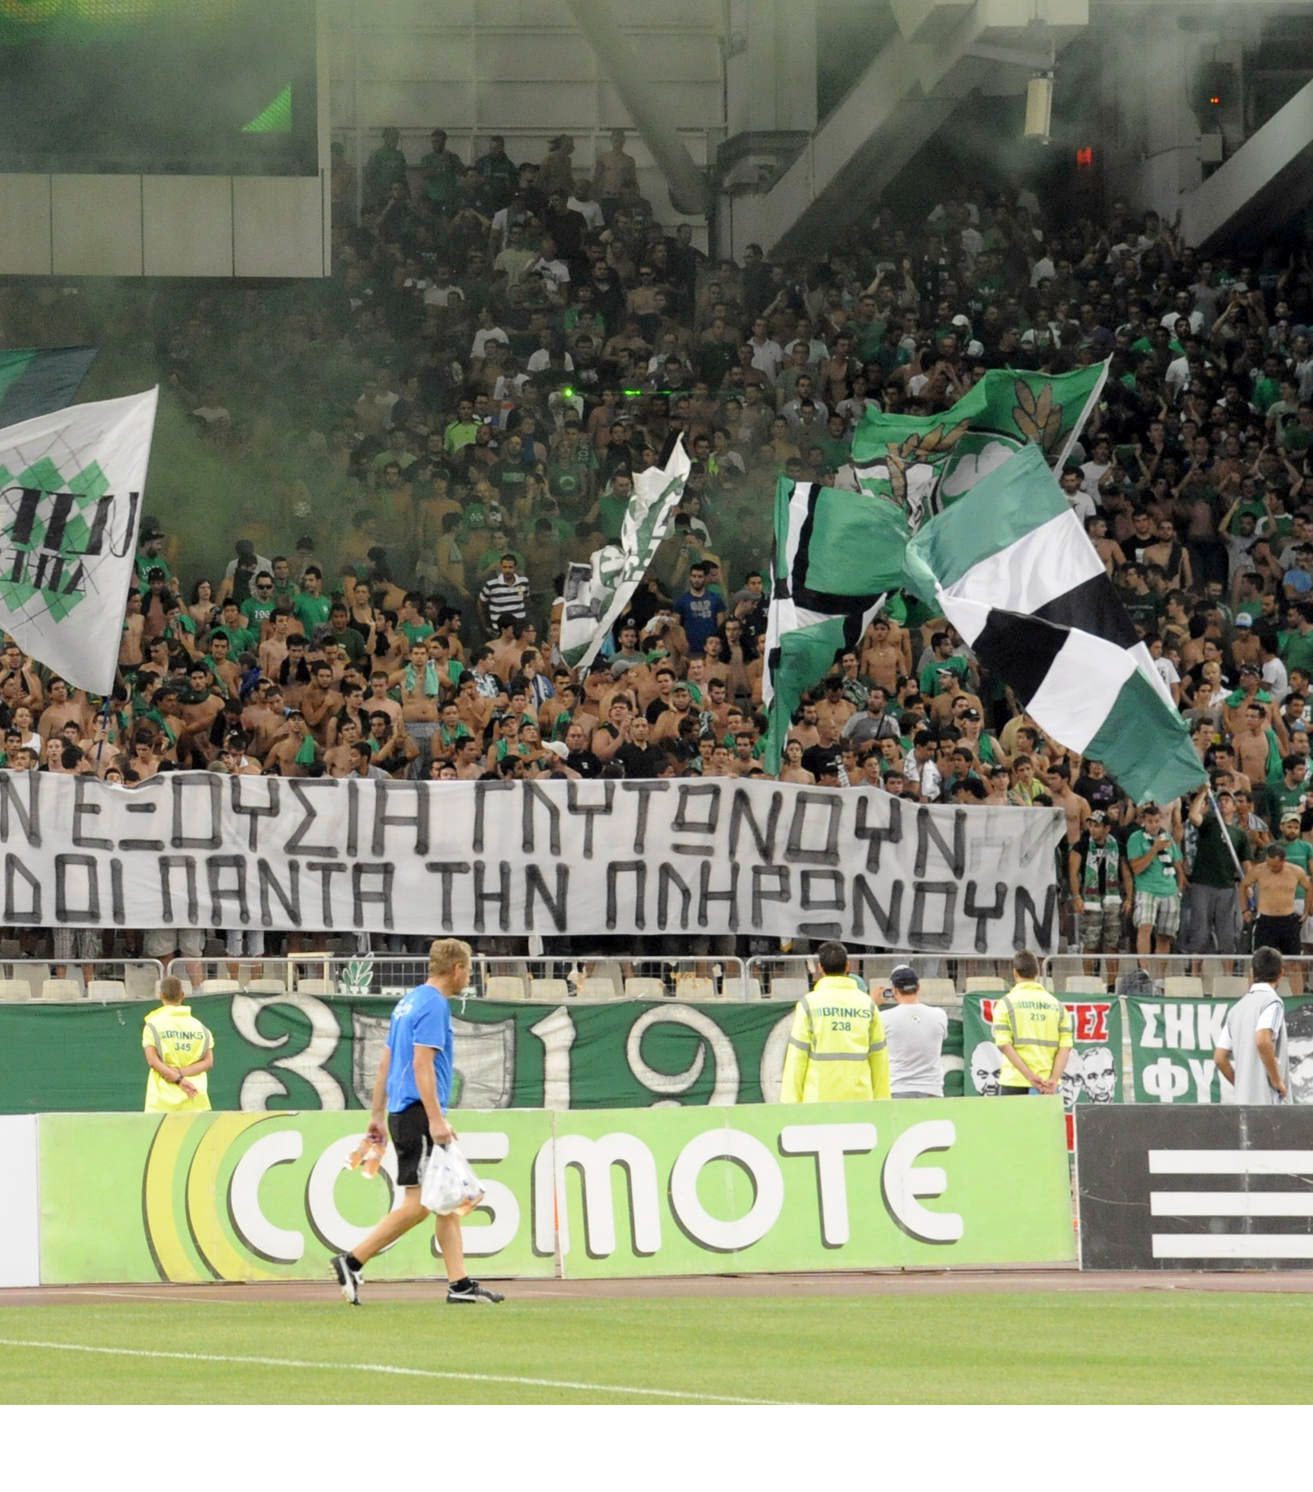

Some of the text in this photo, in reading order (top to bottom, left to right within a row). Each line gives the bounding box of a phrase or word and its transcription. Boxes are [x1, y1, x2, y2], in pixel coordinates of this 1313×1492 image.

[158, 853, 396, 931] ΠΑΝΤΑ
[425, 859, 569, 932] ΤΗΝ
[822, 1006, 871, 1019] BRINKS
[831, 1021, 851, 1032] 238
[1138, 1003, 1229, 1050] ΣΗΚ
